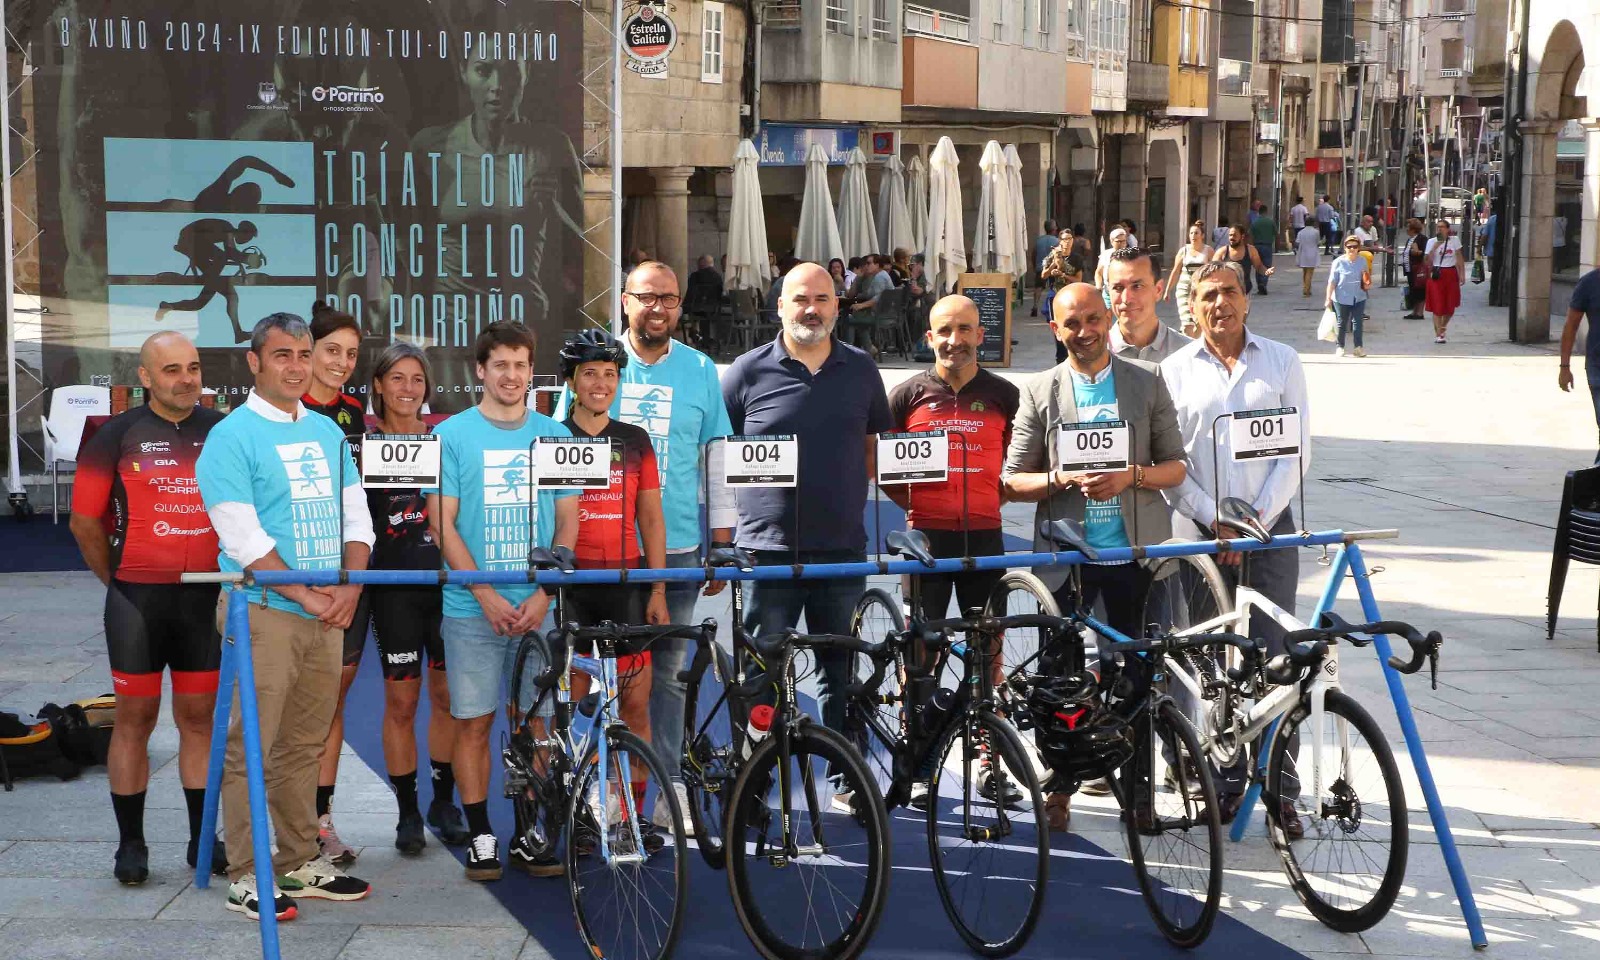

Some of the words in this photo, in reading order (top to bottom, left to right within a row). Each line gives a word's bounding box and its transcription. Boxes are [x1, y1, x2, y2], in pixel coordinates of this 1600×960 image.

[630, 23, 666, 34] Estrella
[61, 17, 70, 46] 8
[88, 16, 146, 50] XUÑO
[464, 30, 558, 61] PORRIÑO
[632, 34, 665, 44] Galicia
[312, 86, 326, 102] O
[322, 141, 524, 208] TRÍATLON
[324, 222, 524, 278] CONCELLO
[1250, 418, 1284, 438] 001
[894, 440, 932, 460] 003
[1076, 431, 1114, 450] 005
[381, 444, 422, 462] 007
[555, 446, 594, 466] 006
[742, 444, 780, 463] 004
[158, 486, 200, 494] PORRI
[154, 503, 207, 513] QUADRAL
[404, 512, 424, 520] GIA
[485, 524, 538, 542] CONCELO
[315, 536, 341, 555] PORRI
